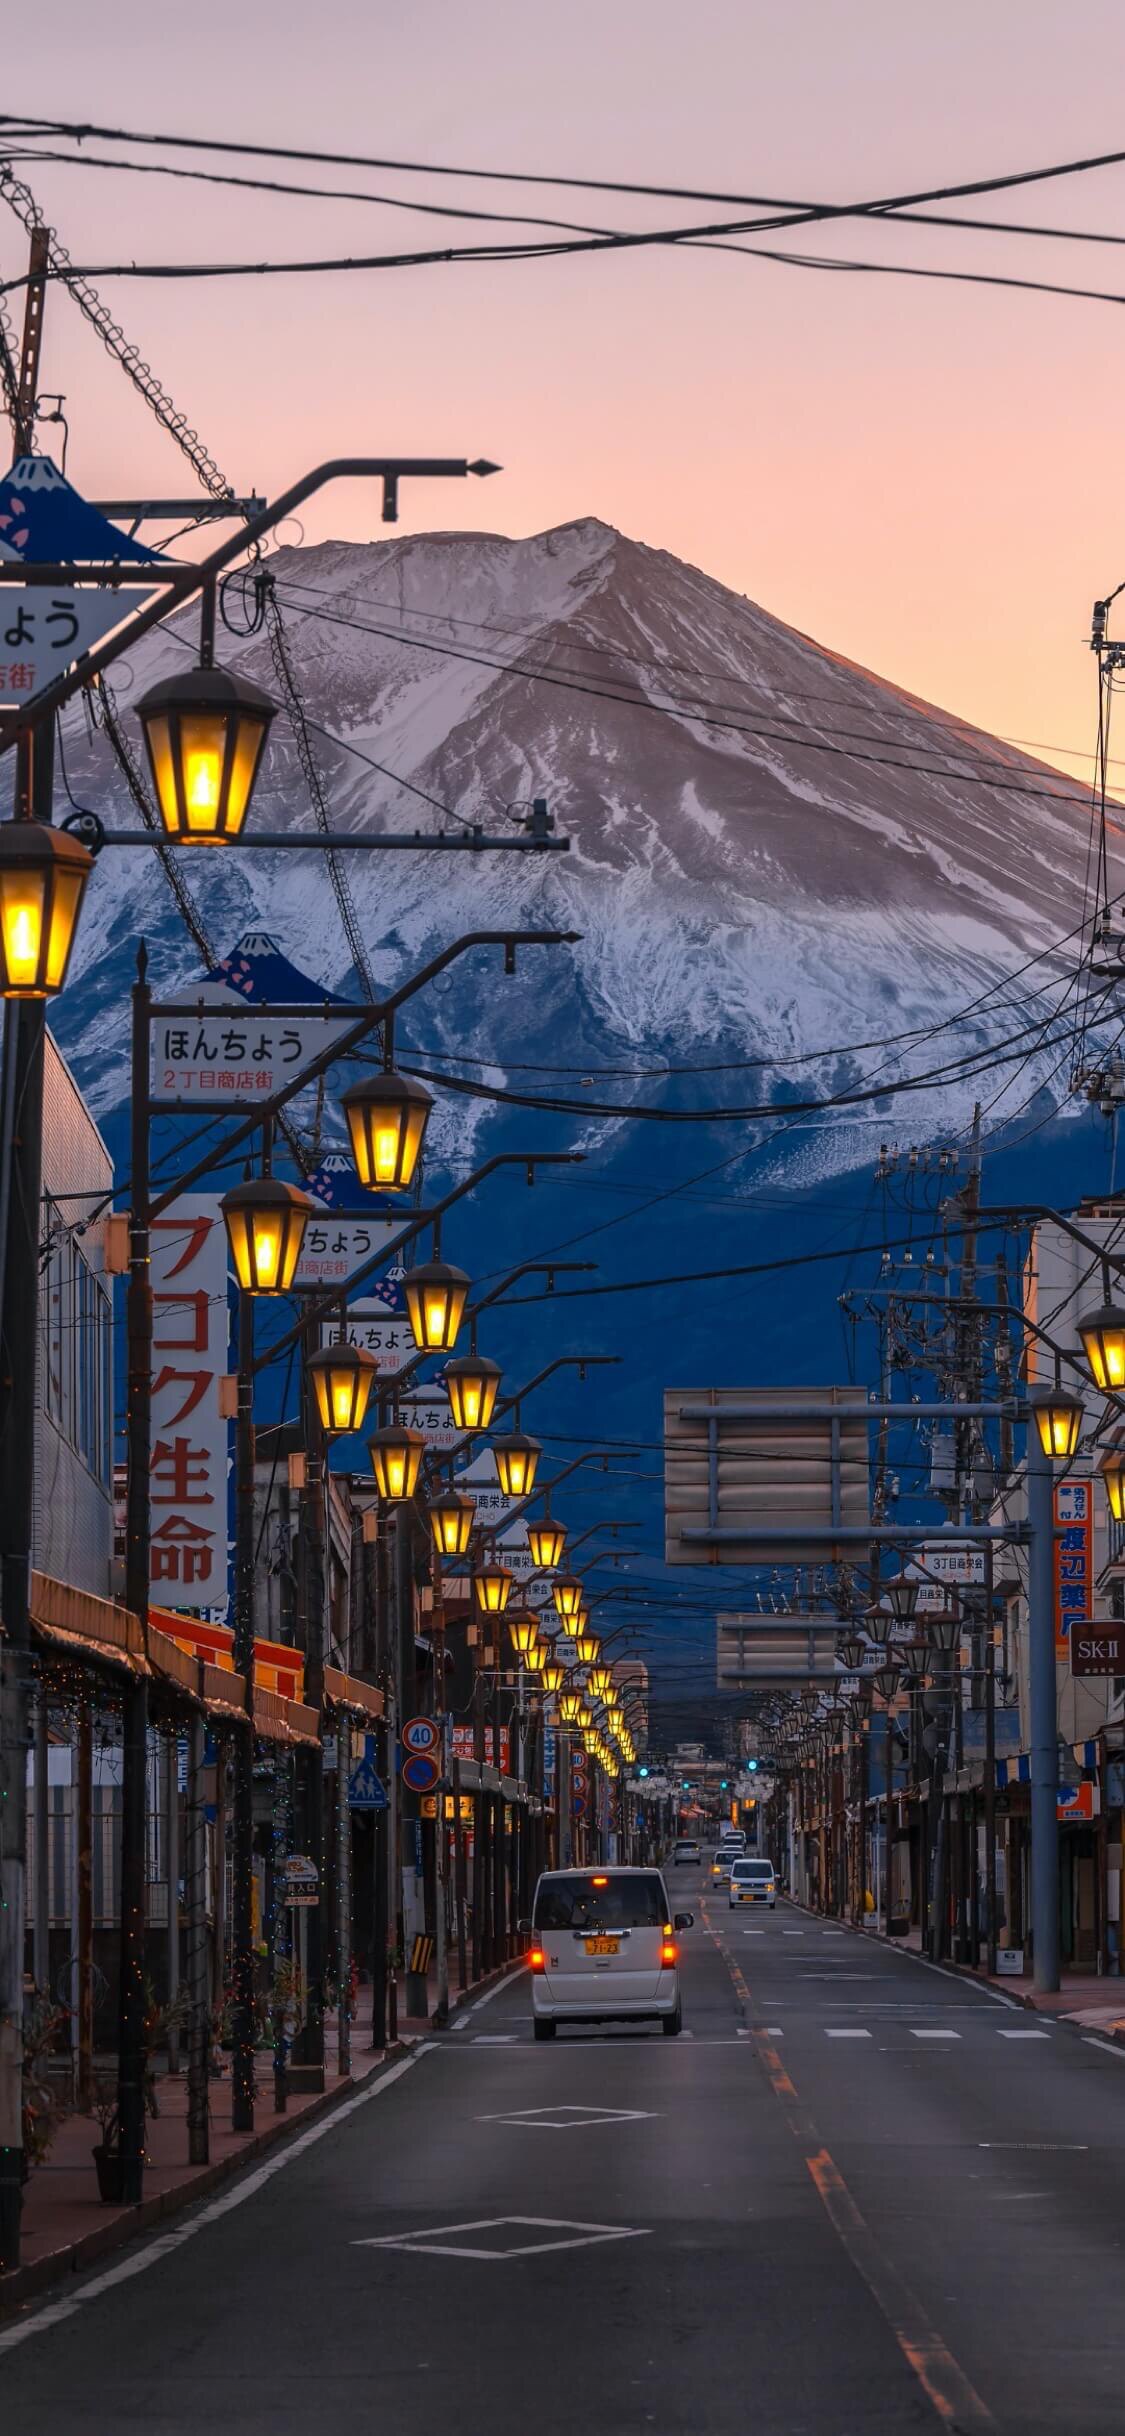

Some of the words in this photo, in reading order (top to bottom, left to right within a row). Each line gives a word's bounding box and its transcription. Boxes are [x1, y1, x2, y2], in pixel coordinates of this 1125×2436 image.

[5, 600, 79, 648] ょう
[165, 1029, 302, 1063] ほんちょう
[164, 1070, 273, 1089] 2丁目商店街
[302, 1228, 371, 1254] ちょう
[150, 1215, 216, 1583] フコク生命
[489, 1555, 534, 1569] 丁目商栄
[411, 1728, 431, 1743] 40
